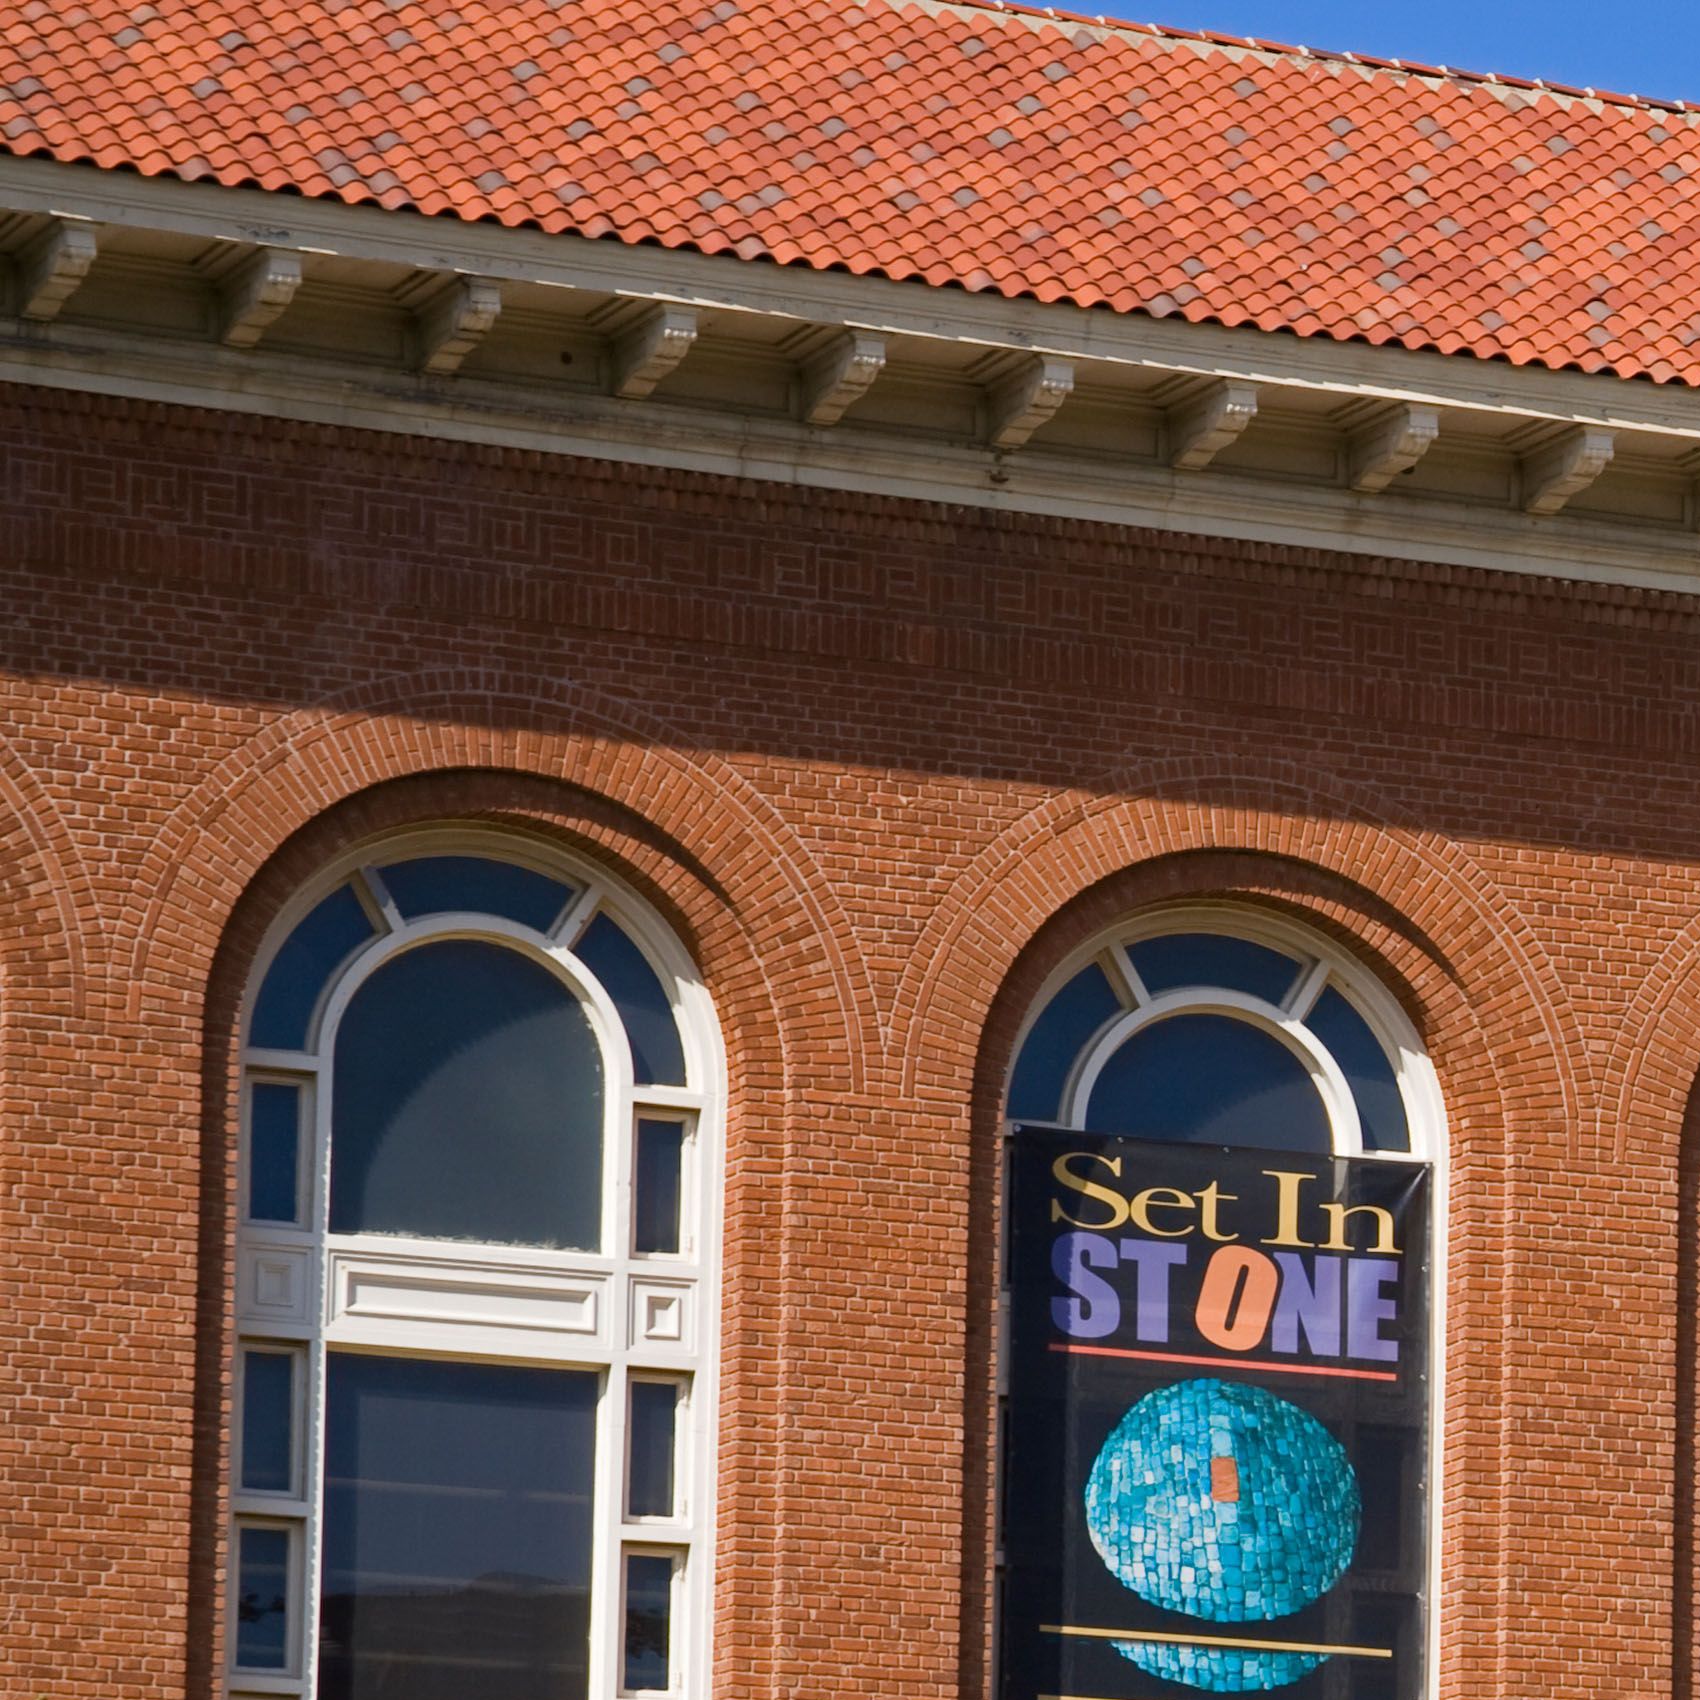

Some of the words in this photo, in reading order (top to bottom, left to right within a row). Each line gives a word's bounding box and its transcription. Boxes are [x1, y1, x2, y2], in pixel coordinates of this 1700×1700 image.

[1051, 1151, 1239, 1243] Set
[1260, 1170, 1403, 1254] In
[1050, 1231, 1399, 1362] STONE
